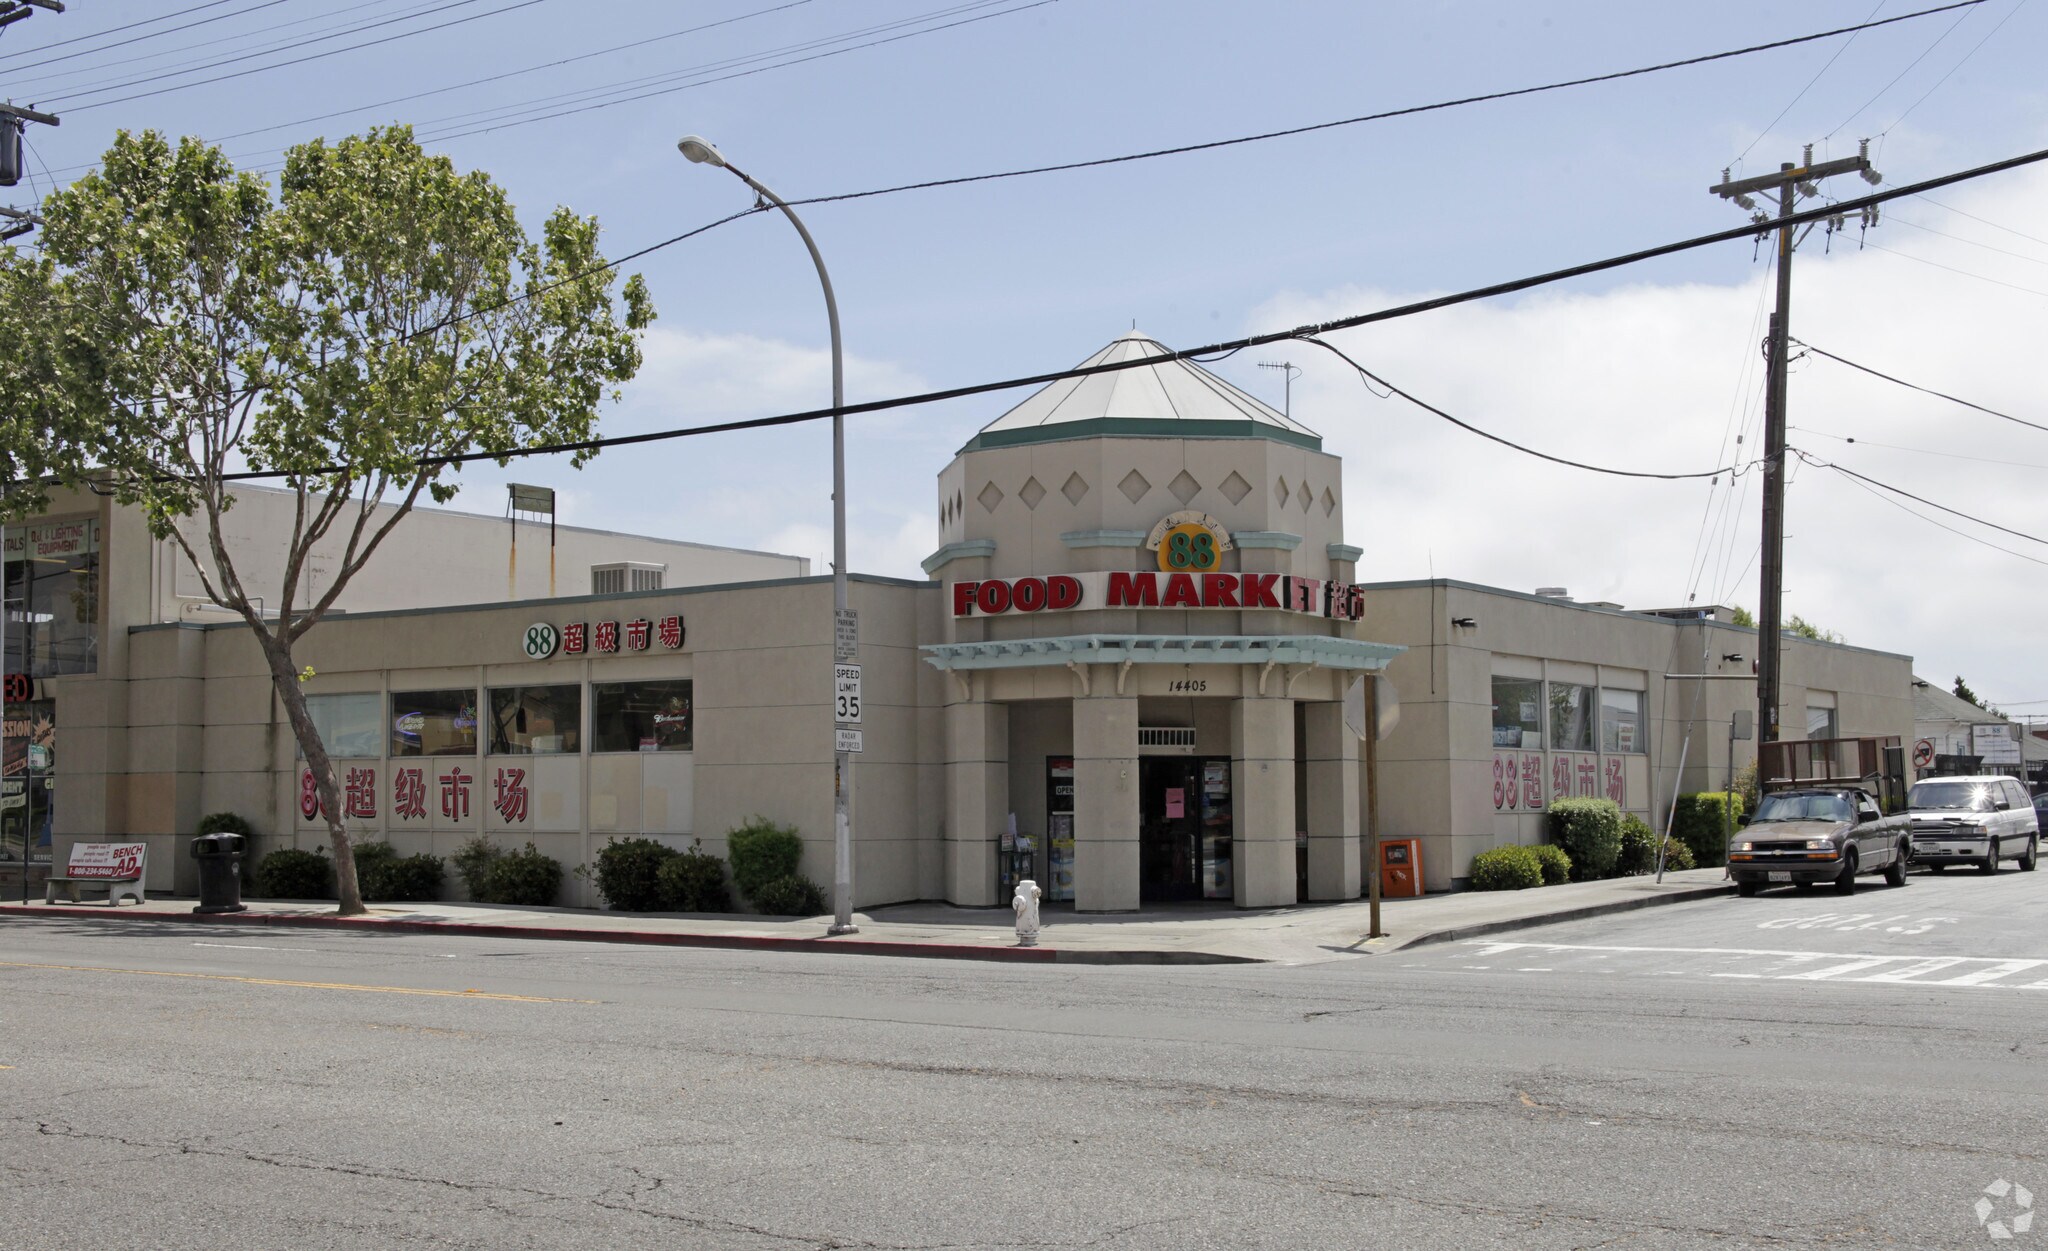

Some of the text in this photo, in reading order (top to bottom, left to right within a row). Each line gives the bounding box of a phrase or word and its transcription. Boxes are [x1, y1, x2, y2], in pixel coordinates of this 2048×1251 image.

[51, 525, 84, 541] LIGHTING
[37, 540, 79, 555] EQUIPMENT
[1168, 532, 1216, 569] 88
[953, 572, 1321, 616] FOOD MARKET
[843, 610, 857, 618] TRUCK
[837, 619, 856, 628] PARKING
[526, 626, 551, 656] 88
[563, 615, 682, 654] 超級市場
[836, 668, 860, 680] SPEED
[839, 682, 857, 693] LIMIT
[1168, 680, 1207, 692] 14405
[837, 695, 860, 717] 35
[841, 732, 857, 740] RADAR
[838, 740, 860, 750] ENFORCED
[3, 781, 24, 793] RENT
[1056, 786, 1074, 795] OPEN
[113, 844, 143, 859] BENCH
[113, 856, 137, 877] AD
